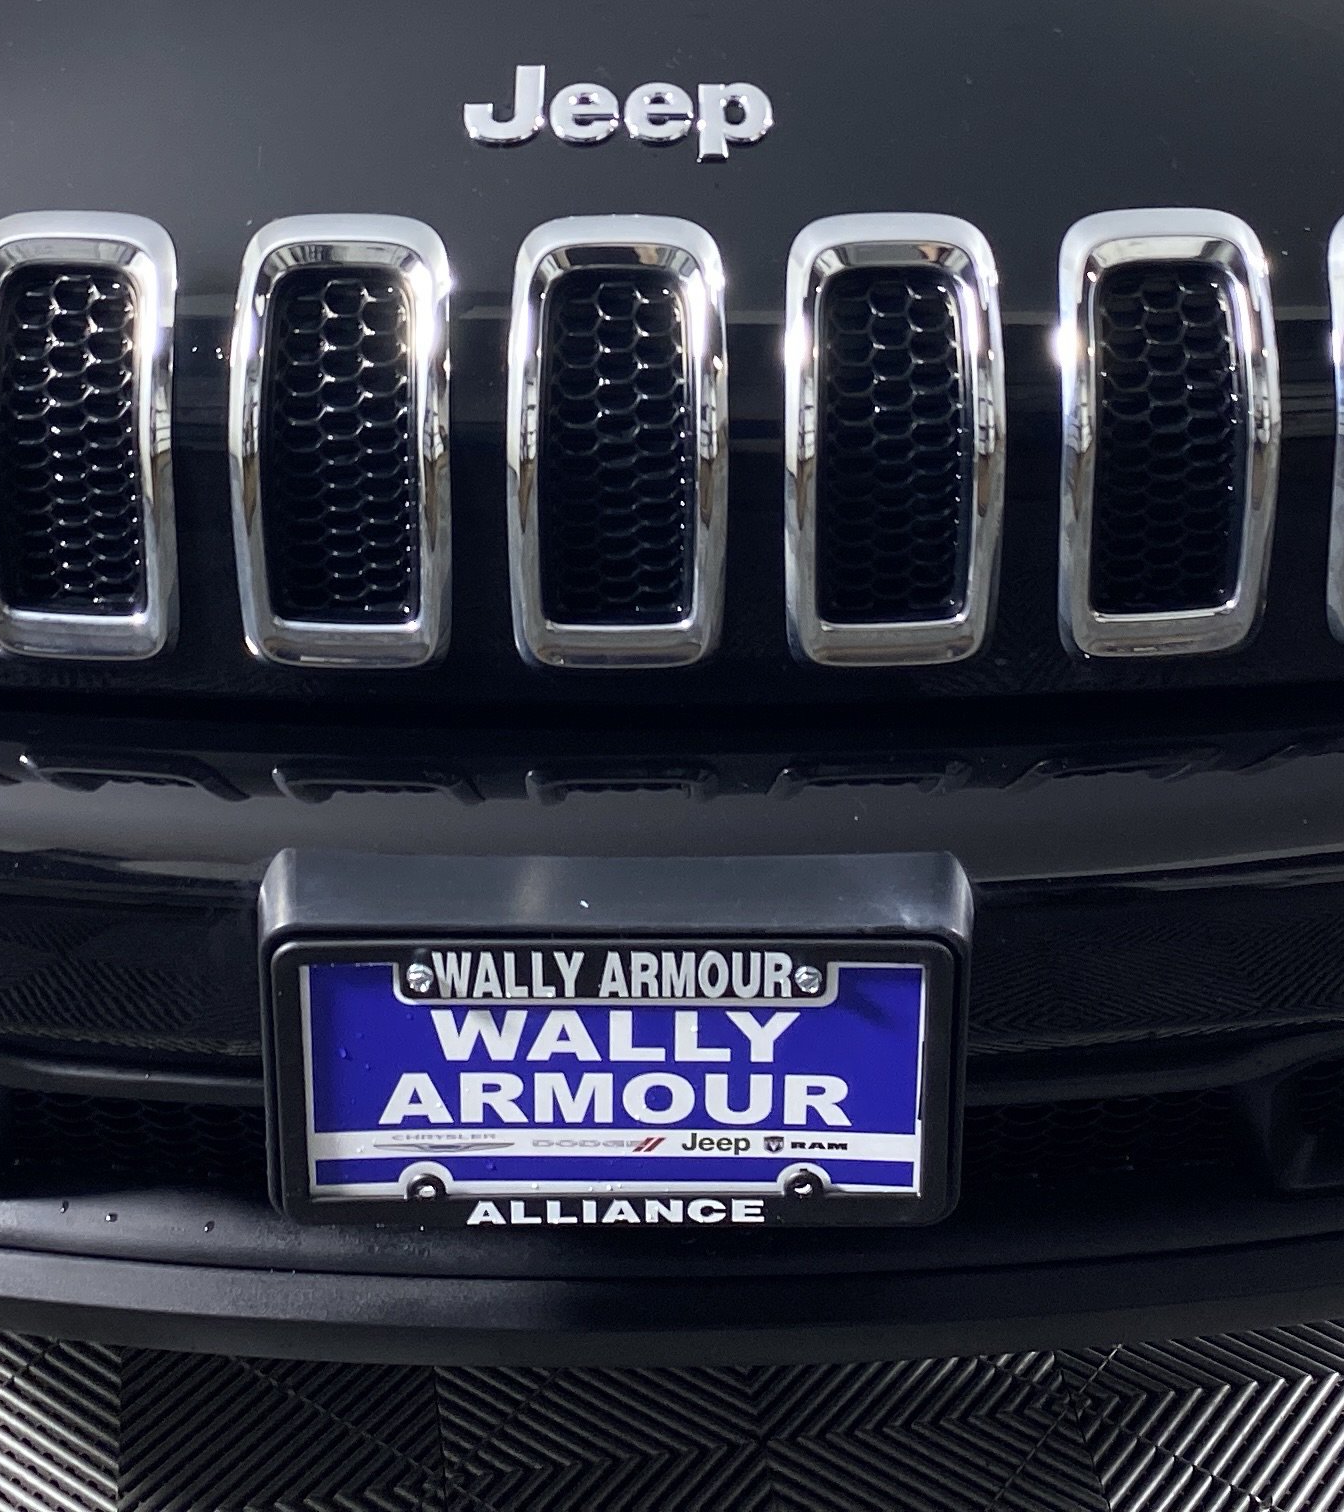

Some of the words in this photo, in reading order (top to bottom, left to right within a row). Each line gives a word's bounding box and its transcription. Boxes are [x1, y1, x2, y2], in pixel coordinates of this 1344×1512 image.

[464, 65, 774, 163] Jeep
[432, 951, 584, 998] WALLY
[599, 951, 792, 998] ARMOUR
[430, 1009, 801, 1062] WALLY
[378, 1071, 852, 1127] ARMOUR
[391, 1133, 497, 1141] CHRYSLER
[681, 1132, 751, 1155] Jeep
[790, 1141, 848, 1151] RAM
[466, 1199, 766, 1225] ALLIANCE
